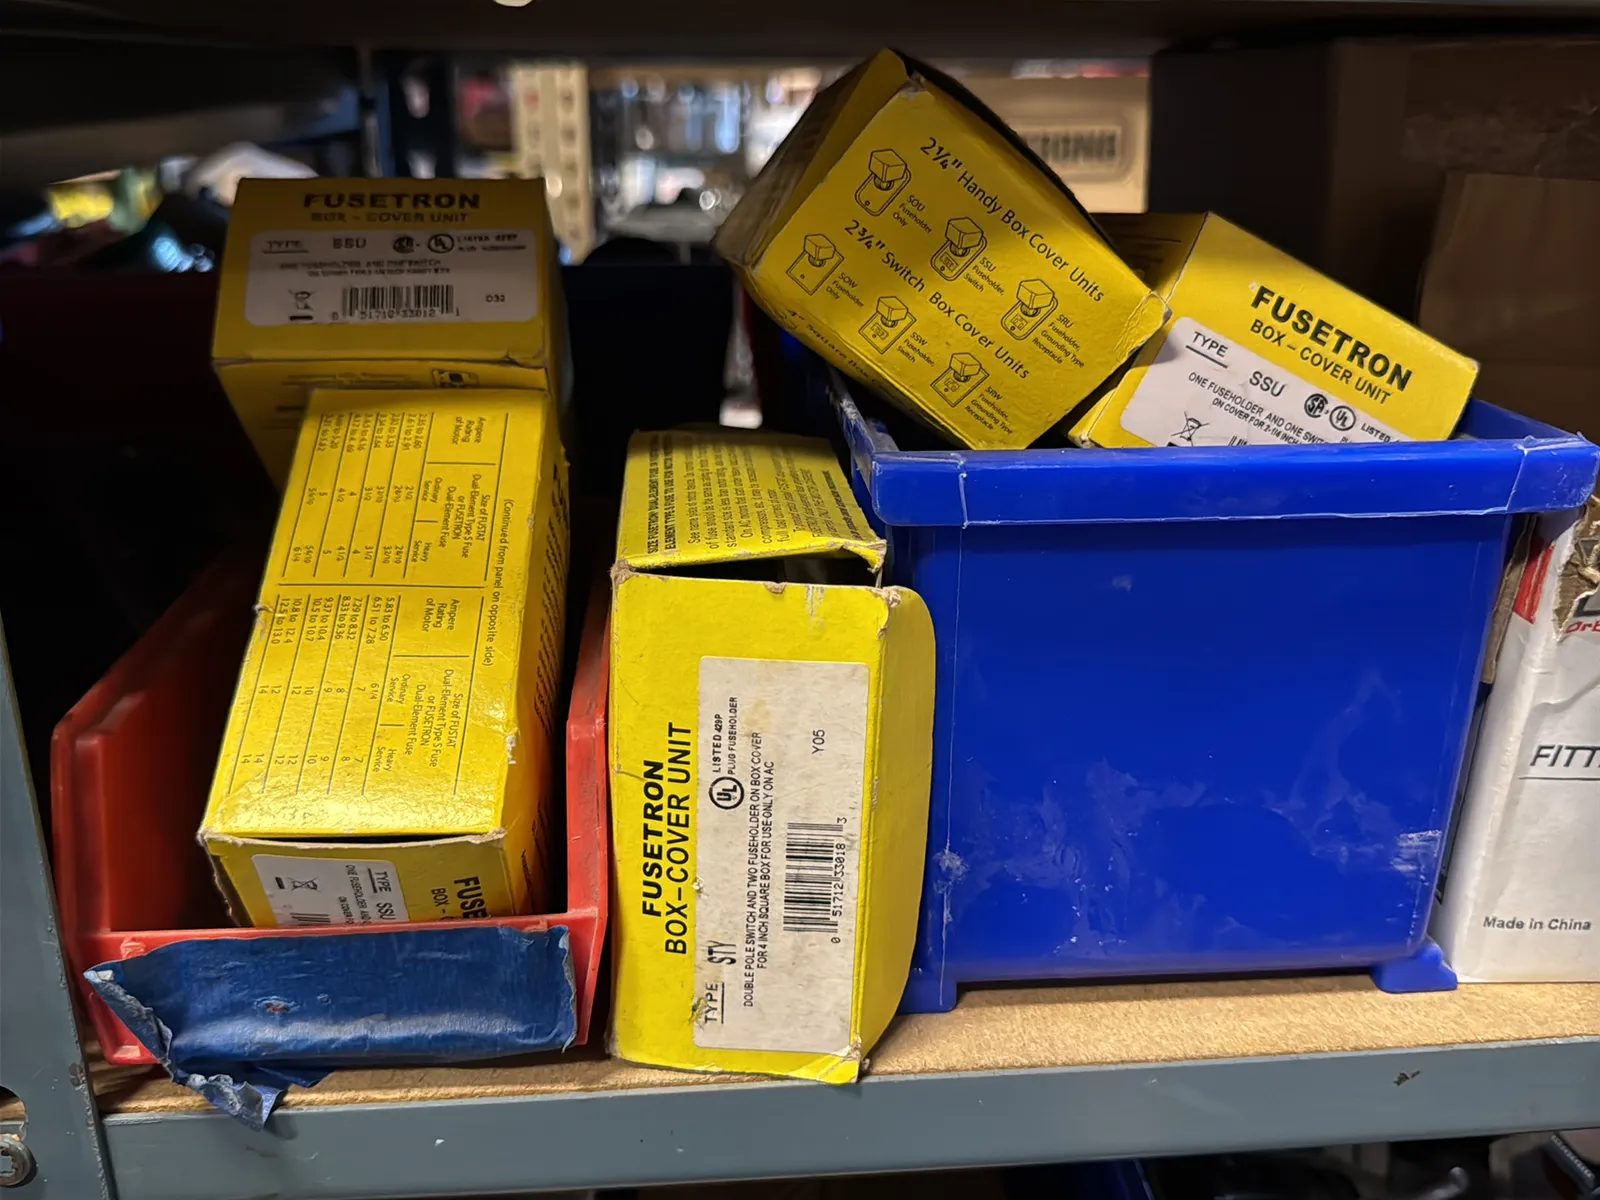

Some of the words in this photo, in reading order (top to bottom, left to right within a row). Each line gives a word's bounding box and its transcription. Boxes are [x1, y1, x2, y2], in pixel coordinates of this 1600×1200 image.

[303, 193, 480, 209] FUSETRON
[906, 194, 925, 212] SOU
[430, 212, 467, 223] UNIT
[892, 211, 908, 227] Only
[957, 170, 1002, 214] Handy
[999, 208, 1029, 238] Box
[1028, 232, 1069, 270] Cover
[1069, 266, 1104, 302] Units
[978, 256, 996, 272] SSU
[837, 272, 859, 288] SOW
[963, 272, 984, 292] Switch
[825, 285, 840, 300] Only
[881, 251, 924, 291] Switch
[928, 291, 955, 317] Box
[954, 313, 995, 348] Cover
[994, 345, 1029, 378] Units
[909, 331, 928, 346] SSW
[1253, 287, 1410, 389] FUSETRON
[896, 345, 915, 363] Switch
[1069, 352, 1084, 368] Type
[1250, 318, 1286, 347] BOX
[1299, 346, 1352, 384] COVER
[1354, 376, 1391, 404] UNIT
[1192, 331, 1228, 357] TYPE
[1249, 370, 1285, 397] SSU
[1360, 422, 1390, 446] LISTED
[1188, 371, 1208, 388] ONE
[1207, 381, 1264, 416] FUSEHOLDER
[1264, 412, 1285, 427] AND
[1284, 421, 1304, 437] ONE
[1211, 397, 1225, 408] ON
[1223, 403, 1250, 421] COVER
[1247, 415, 1265, 429] FOR
[499, 498, 514, 544] (Continued
[687, 531, 701, 543] See
[703, 526, 718, 540] fuse
[720, 520, 737, 547] standard
[496, 545, 508, 565] from
[646, 538, 659, 554] SIZE
[705, 541, 719, 549] of
[492, 566, 503, 588] panel
[310, 597, 323, 612] 10.5
[322, 596, 334, 613] 9.37
[339, 595, 351, 612] 8.33
[351, 596, 363, 612] 7.29
[370, 595, 382, 612] 6.51
[383, 596, 395, 613] 5.83
[424, 597, 435, 607] of
[491, 590, 500, 602] on
[308, 613, 318, 623] to
[319, 614, 330, 623] to
[337, 612, 347, 622] to
[348, 613, 359, 623] to
[368, 616, 379, 625] to
[381, 614, 391, 623] to
[421, 607, 434, 632] Motor
[432, 602, 447, 628] Rating
[446, 598, 460, 630] Ampere
[486, 603, 499, 642] opposite
[304, 625, 316, 642] 10.7
[315, 624, 328, 641] 10.4
[333, 622, 346, 640] 9.36
[345, 623, 358, 640] 8.32
[365, 627, 377, 644] 7.28
[378, 623, 390, 641] 6.50
[481, 645, 495, 666] side)
[385, 676, 399, 702] Service
[395, 673, 410, 704] Ordinary
[436, 668, 454, 721] Dual-Element
[426, 695, 435, 704] or
[451, 692, 463, 709] Size
[407, 684, 426, 736] Dual-Element
[449, 709, 461, 720] of
[419, 705, 436, 746] FUSETRON
[432, 722, 446, 741] Type
[727, 696, 737, 751] FUSEHOLDER
[445, 719, 459, 749] FUSTAT
[811, 728, 825, 754] Y05
[403, 737, 417, 755] Fuse
[667, 722, 691, 783] UNIT
[711, 734, 722, 773] LISTED
[749, 730, 762, 765] COVER
[1529, 744, 1600, 768] FITT
[371, 744, 386, 772] Service
[382, 748, 397, 772] Heavy
[428, 748, 441, 767] Fuse
[726, 752, 736, 775] PLUG
[763, 760, 775, 775] AC
[749, 765, 761, 786] BOX
[762, 776, 774, 791] ON
[749, 787, 760, 802] ON
[761, 792, 773, 818] ONLY
[761, 819, 772, 838] USE
[835, 816, 847, 825] 3
[641, 760, 663, 916] FUSETRON
[747, 803, 760, 865] FUSEHOLDER
[760, 839, 771, 859] FOR
[833, 842, 847, 877] 33018
[746, 866, 758, 888] TWO
[759, 860, 771, 880] BOX
[374, 870, 391, 892] TYPE
[430, 887, 449, 907] BOX
[746, 889, 757, 909] AND
[757, 882, 770, 919] SQUARE
[831, 881, 844, 916] 51712
[375, 902, 395, 920] SSU
[744, 910, 756, 945] SWITCH
[757, 920, 769, 942] INCH
[1483, 916, 1525, 931] Made
[1529, 917, 1544, 931] in
[1547, 918, 1592, 931] China
[830, 936, 841, 944] 0
[705, 939, 736, 965] STY
[744, 946, 755, 970] POLE
[756, 950, 768, 969] FOR
[743, 971, 754, 1007] DOUBLE
[704, 981, 718, 1023] TYPE
